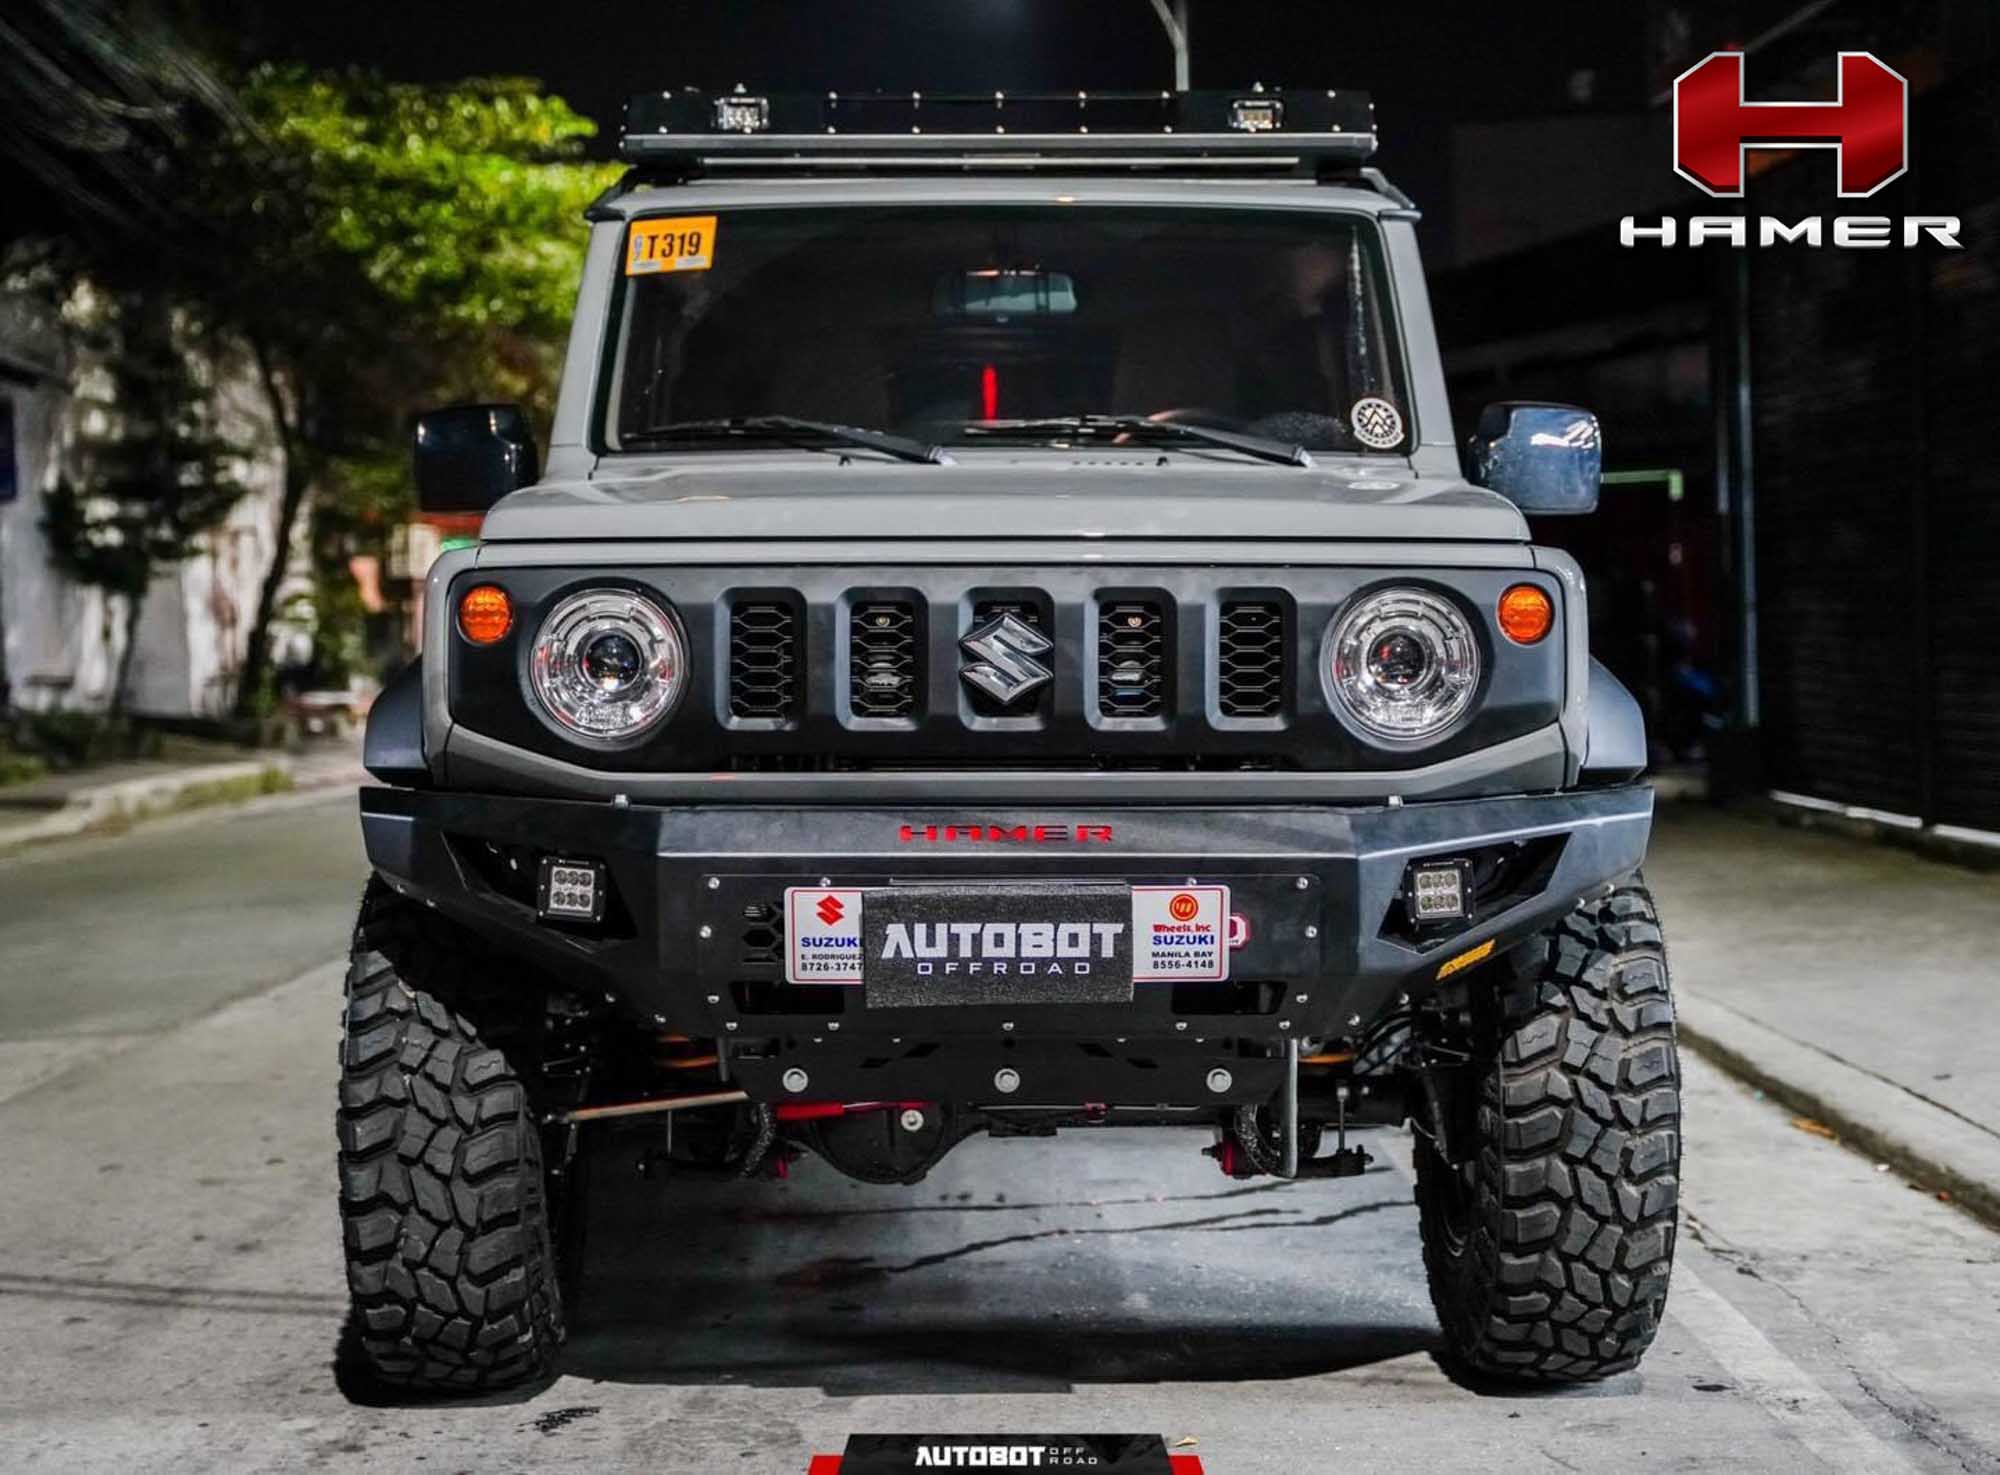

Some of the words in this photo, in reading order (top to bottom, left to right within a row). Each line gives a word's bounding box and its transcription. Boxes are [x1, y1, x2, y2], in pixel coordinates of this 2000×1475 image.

[648, 231, 702, 259] T319
[900, 824, 1113, 843] HAMER
[881, 923, 1125, 959] AUTOBOT
[1152, 935, 1215, 945] SUZUKI
[917, 962, 1090, 975] OFFROAD
[1152, 960, 1215, 969] 8556-4148
